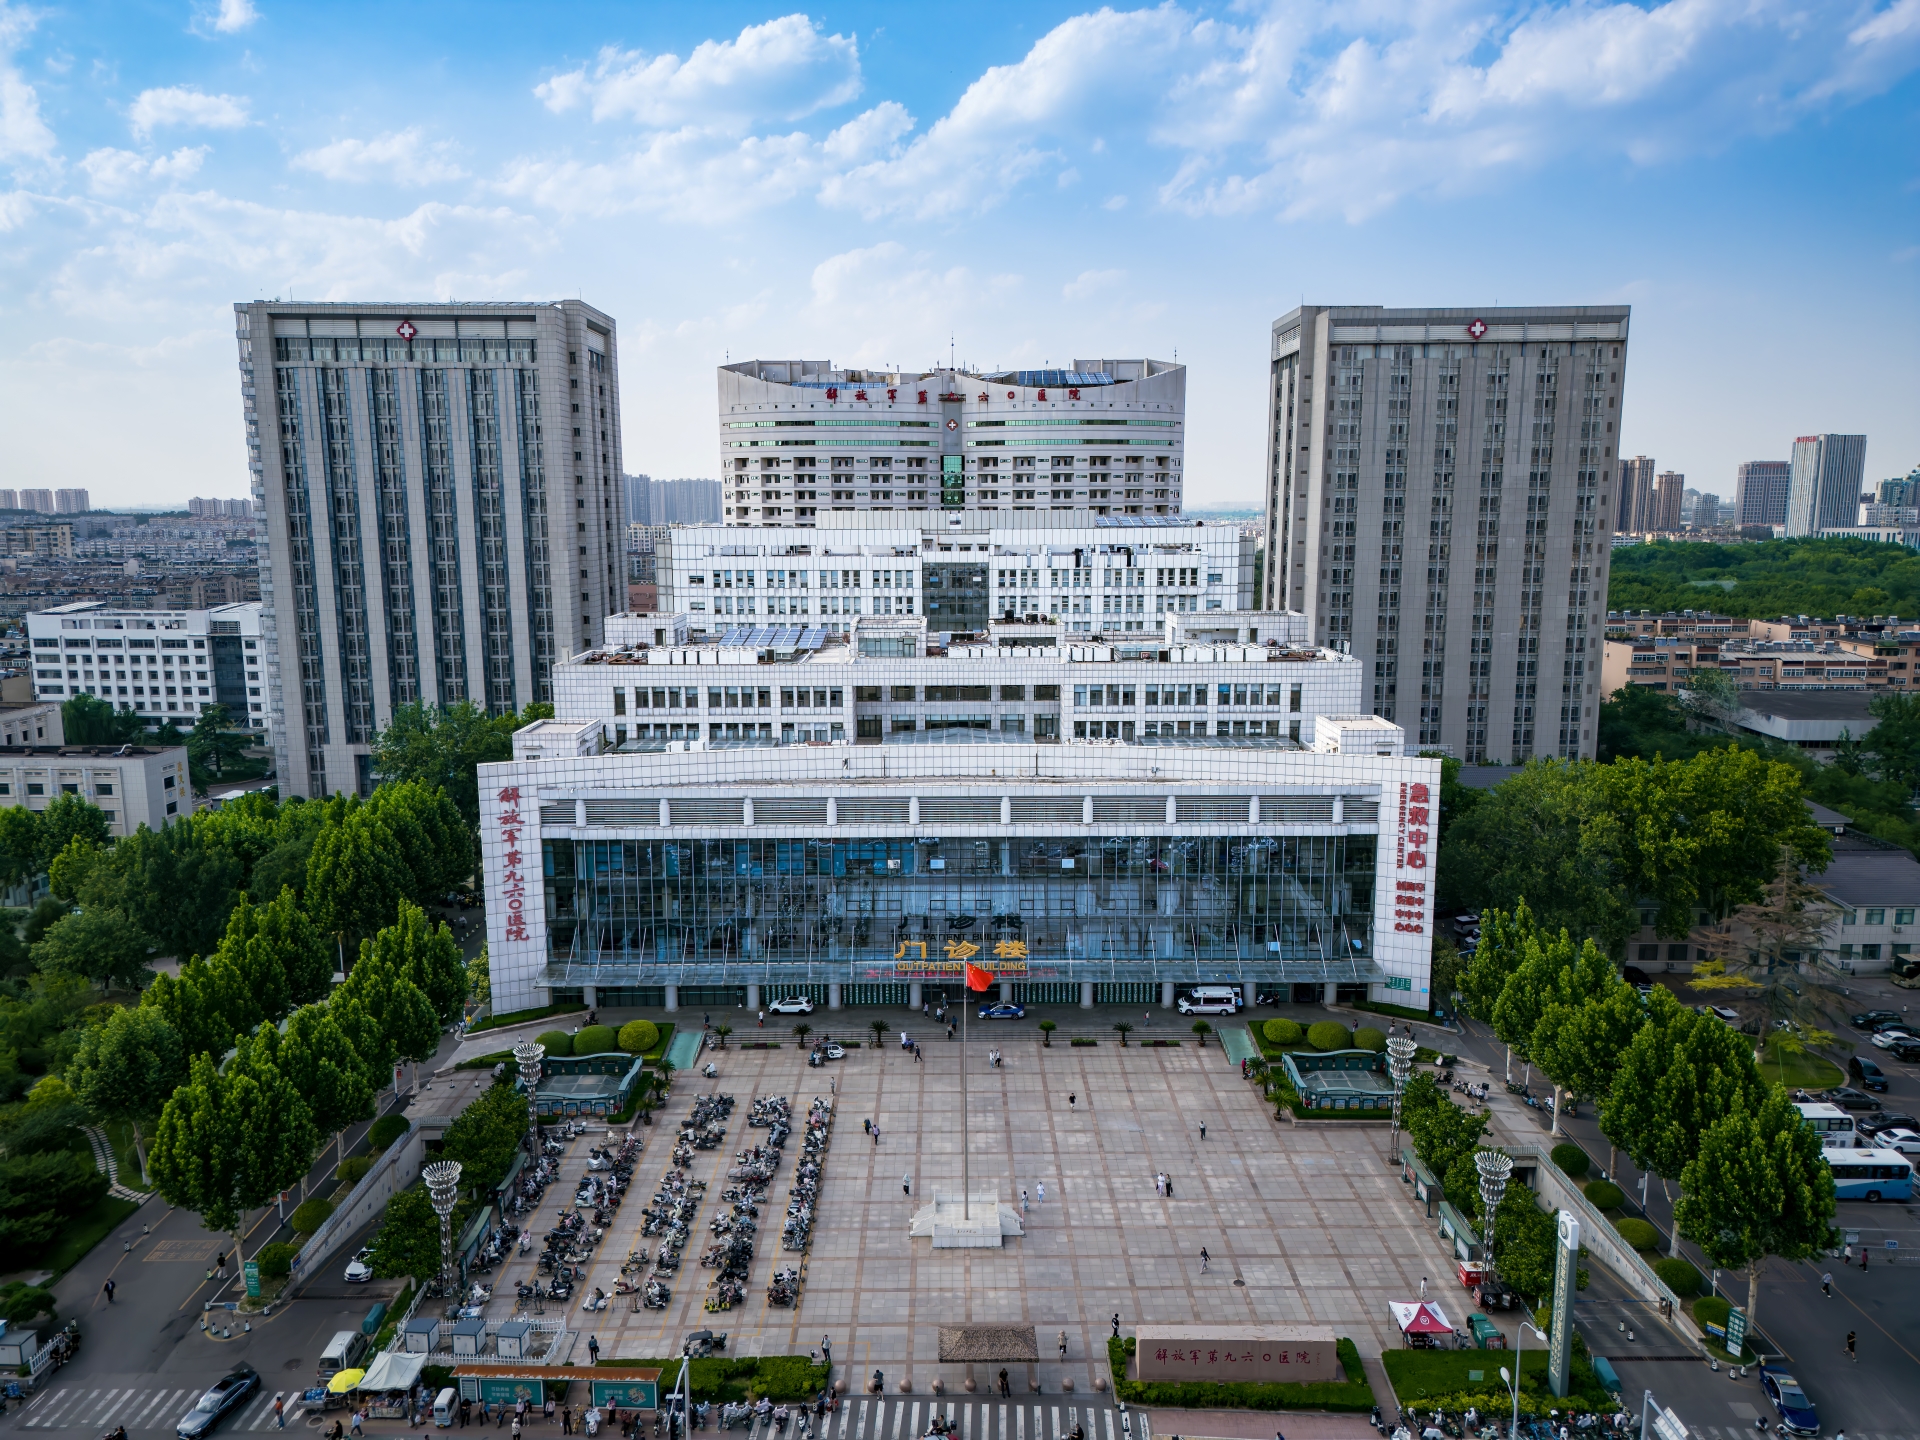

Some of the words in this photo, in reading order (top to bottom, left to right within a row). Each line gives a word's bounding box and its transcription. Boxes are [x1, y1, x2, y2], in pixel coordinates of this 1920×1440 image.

[1398, 782, 1407, 834] EMERGENCY
[1407, 782, 1430, 869] 急救中心
[1396, 837, 1405, 869] CENTER
[894, 940, 1030, 959] 门诊楼
[973, 961, 1026, 971] BUILDING
